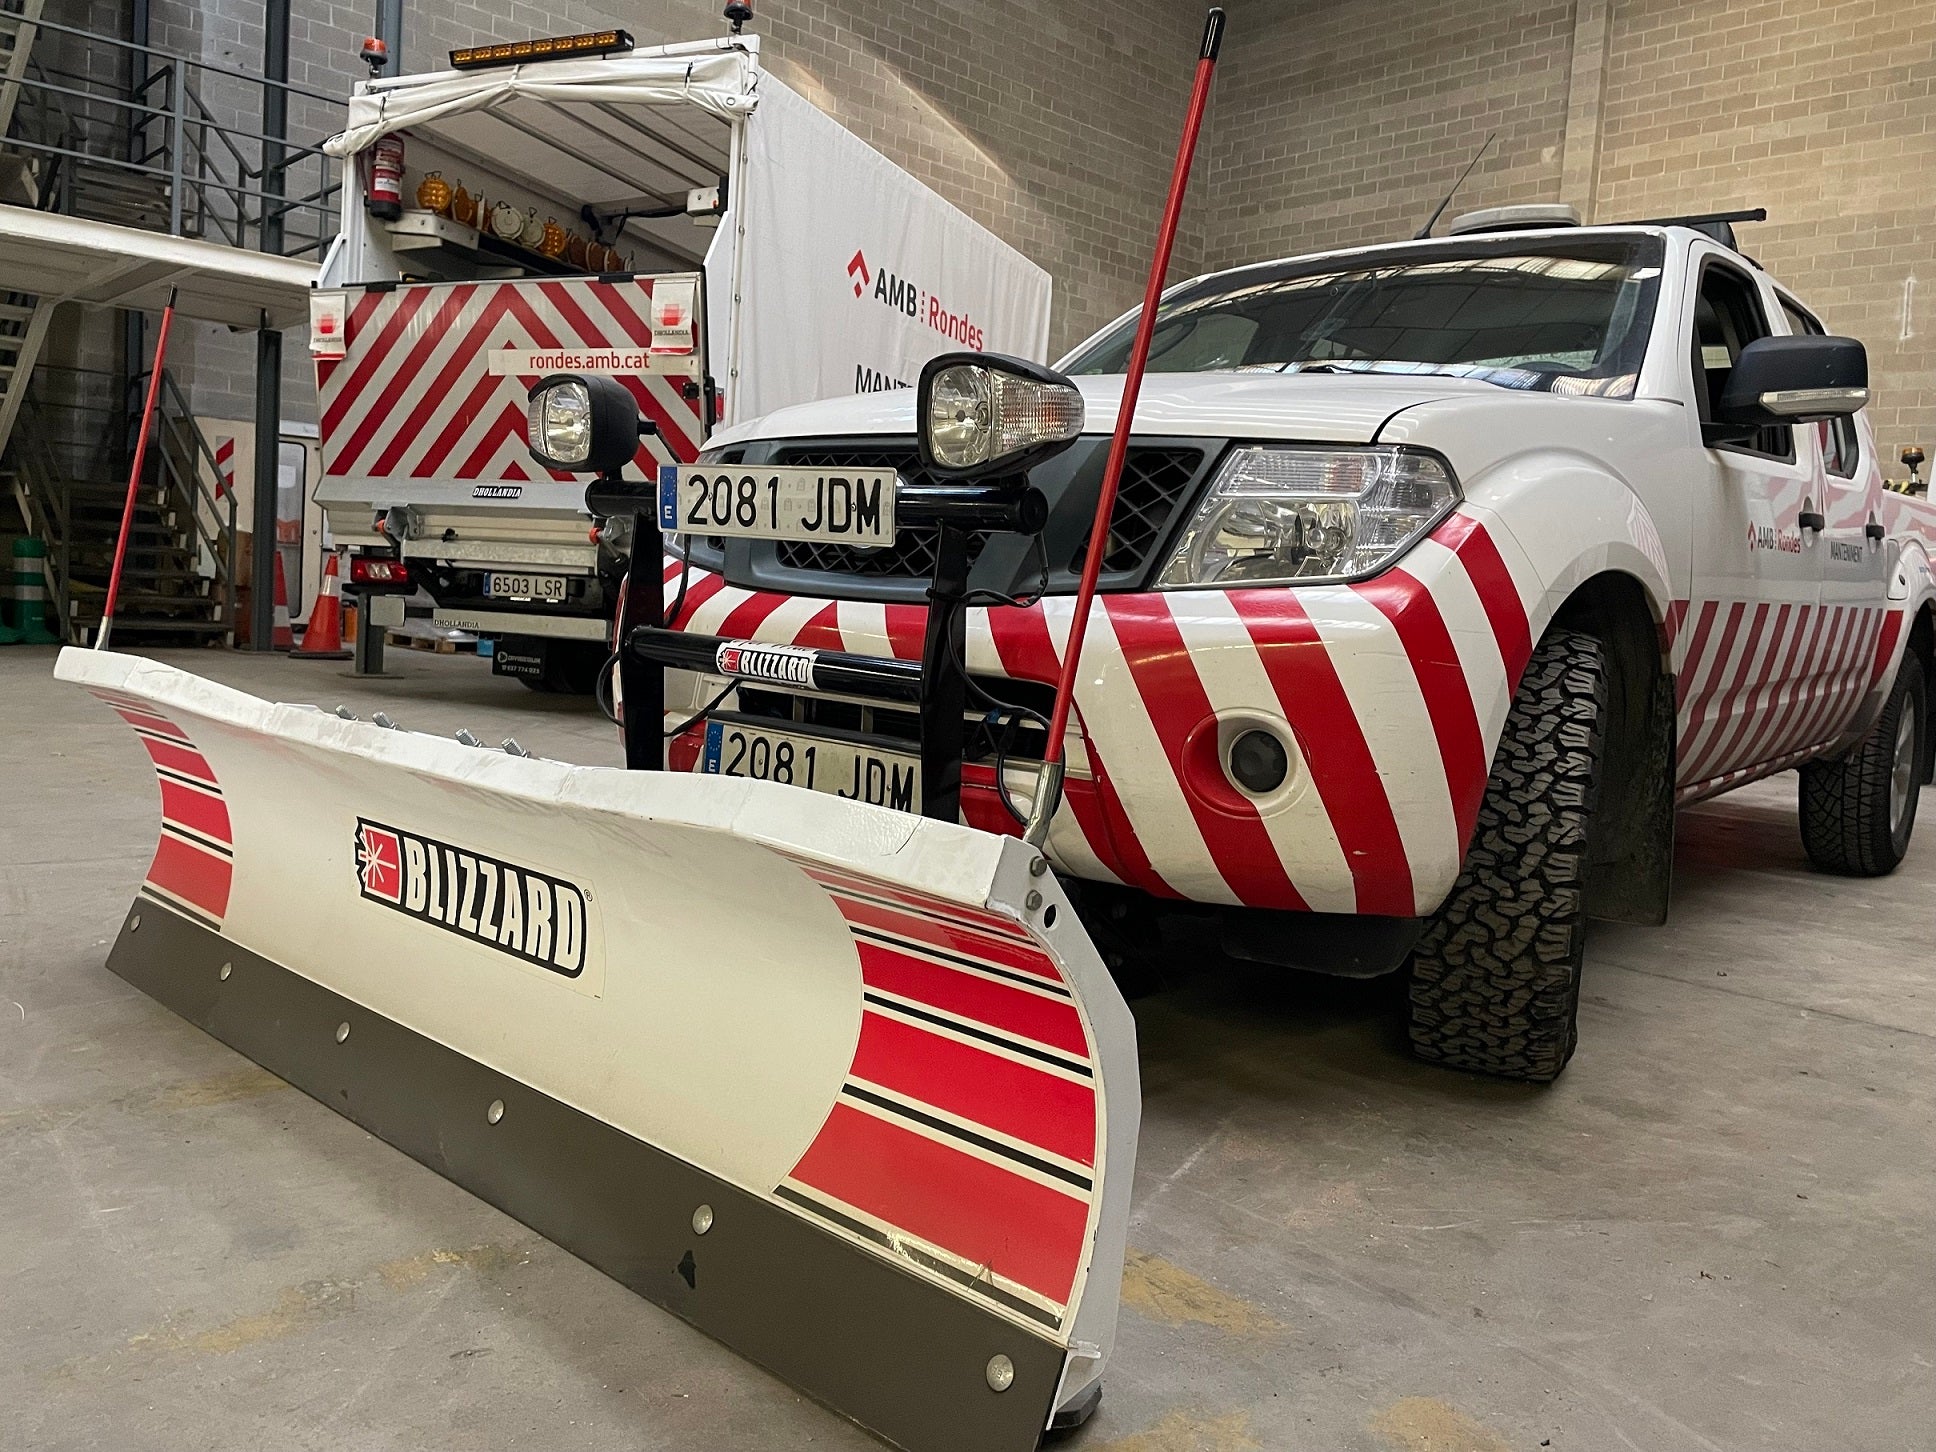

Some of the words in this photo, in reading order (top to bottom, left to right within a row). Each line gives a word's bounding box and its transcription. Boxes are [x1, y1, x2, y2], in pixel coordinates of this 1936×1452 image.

[874, 267, 917, 317] AMB
[929, 296, 983, 352] Rondes
[529, 351, 649, 370] rondes.amb.cat
[472, 486, 522, 498] DHOLLANDIA
[664, 505, 673, 519] E
[687, 474, 779, 530] 2081
[801, 477, 882, 536] JDM
[1757, 526, 1774, 549] AMB
[493, 576, 530, 594] 6503
[534, 580, 563, 597] LSR
[434, 619, 480, 629] DHOLLANDIA
[740, 650, 809, 683] BLIZZARD
[725, 731, 816, 789] 2081
[838, 754, 914, 813] JDM
[403, 836, 583, 971] BLIZZARD
